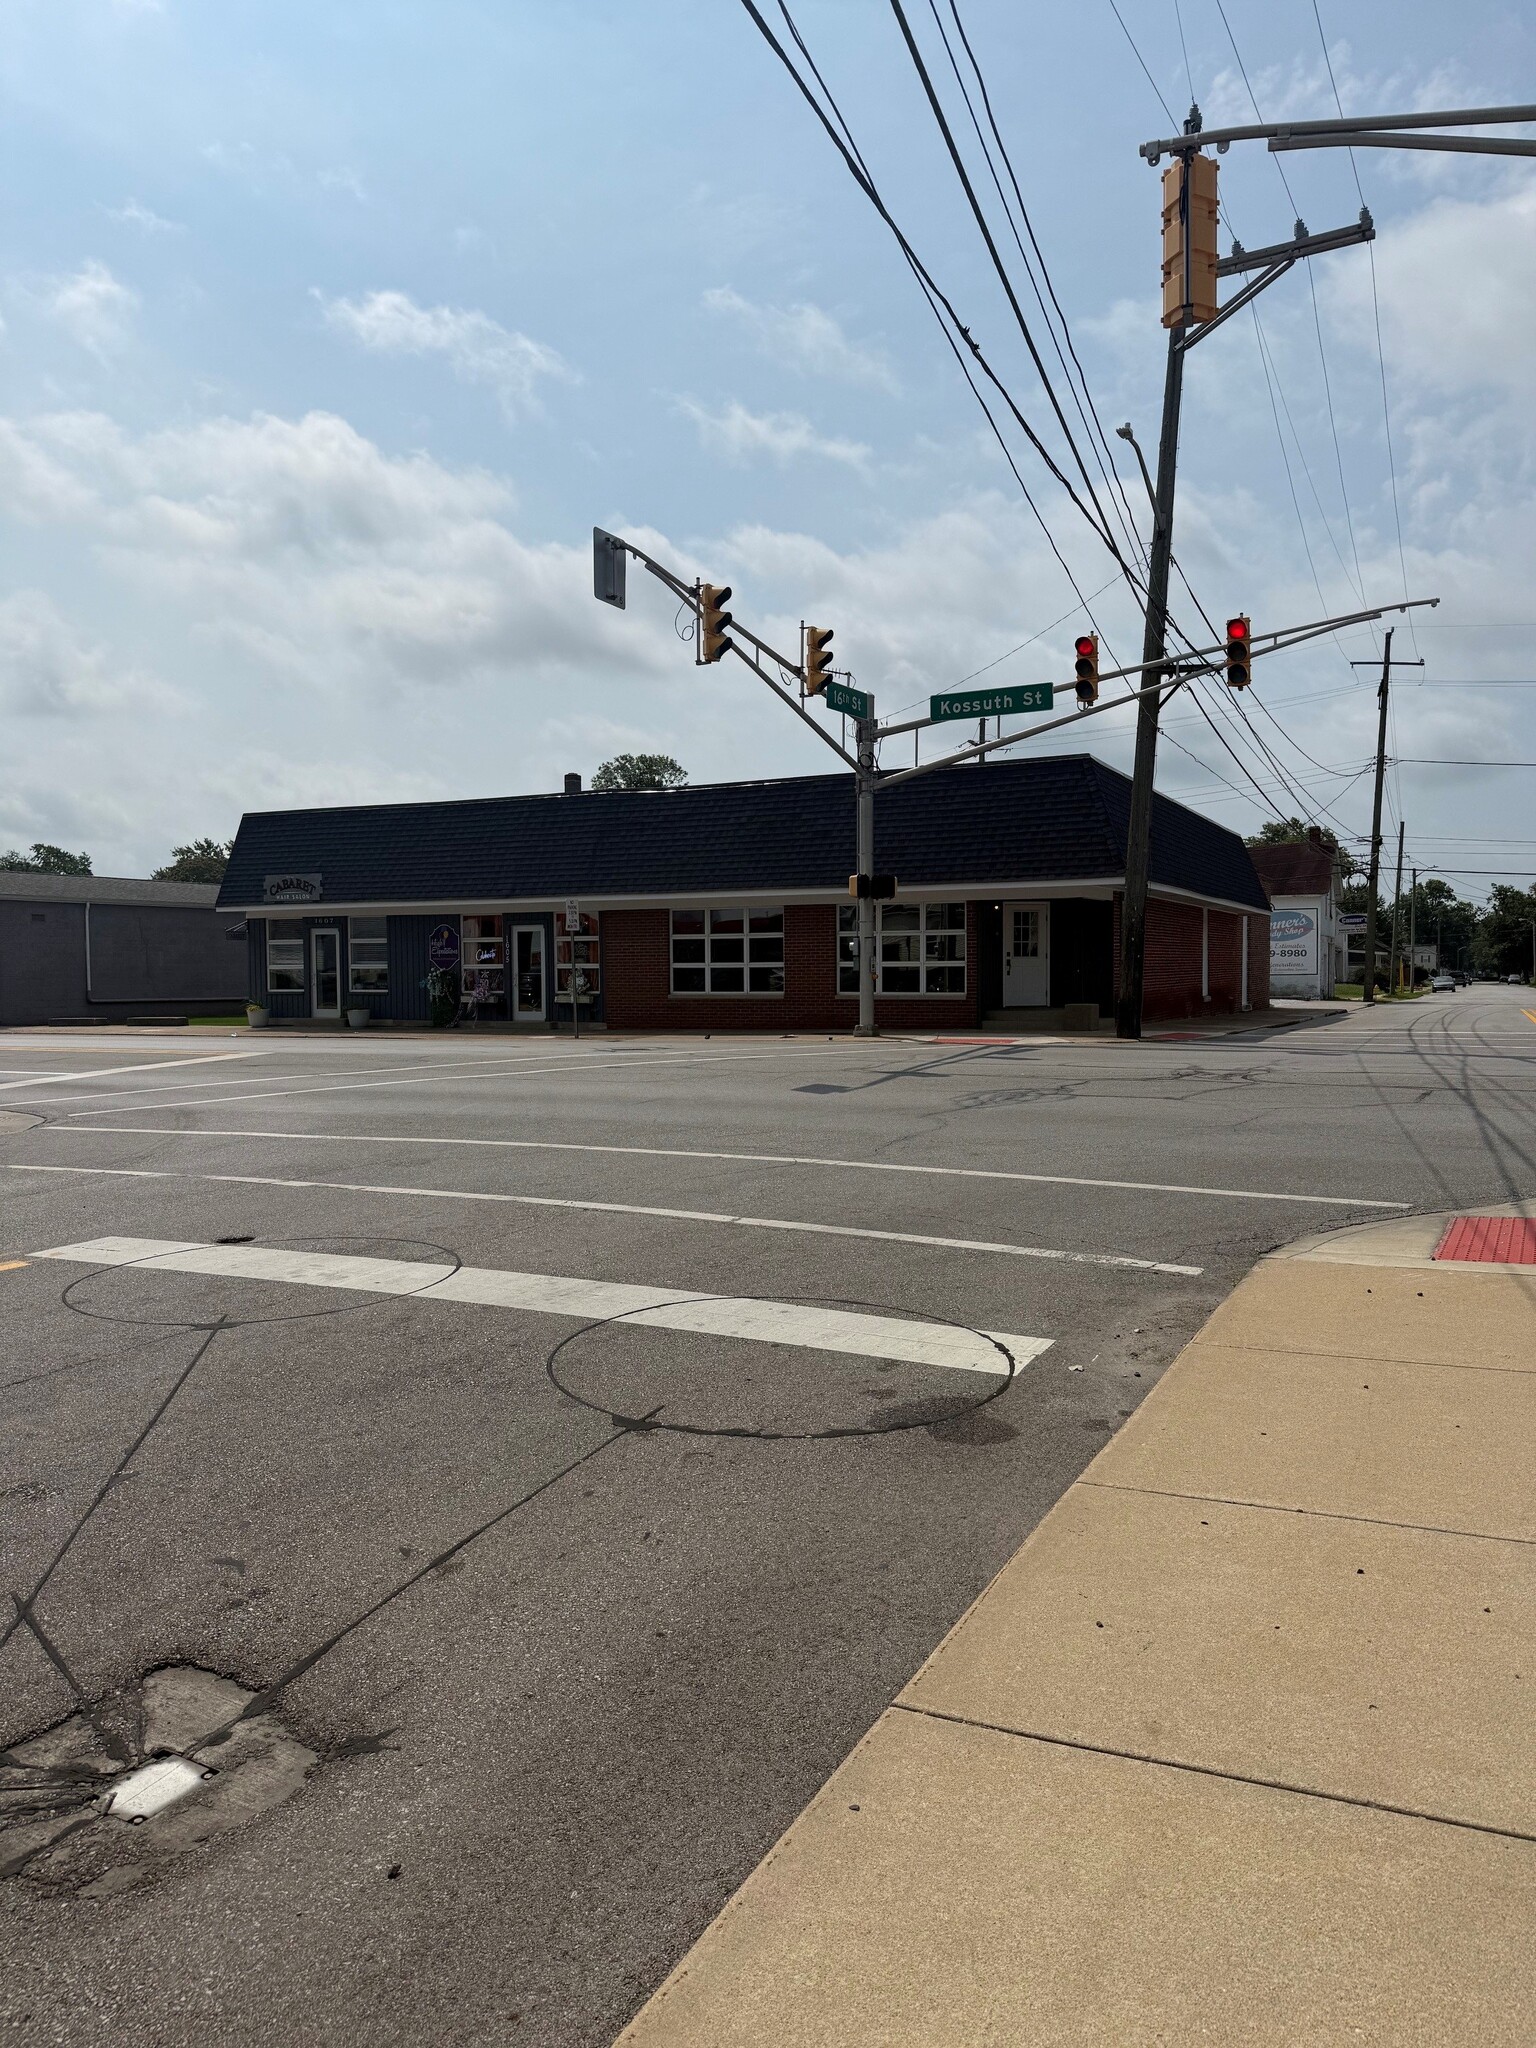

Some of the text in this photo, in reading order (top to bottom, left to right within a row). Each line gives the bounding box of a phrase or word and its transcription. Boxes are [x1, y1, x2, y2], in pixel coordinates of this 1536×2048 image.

[833, 689, 862, 712] 16th St
[940, 690, 1042, 715] Kossuth St
[269, 878, 316, 895] CABARET
[1284, 926, 1304, 935] Shop
